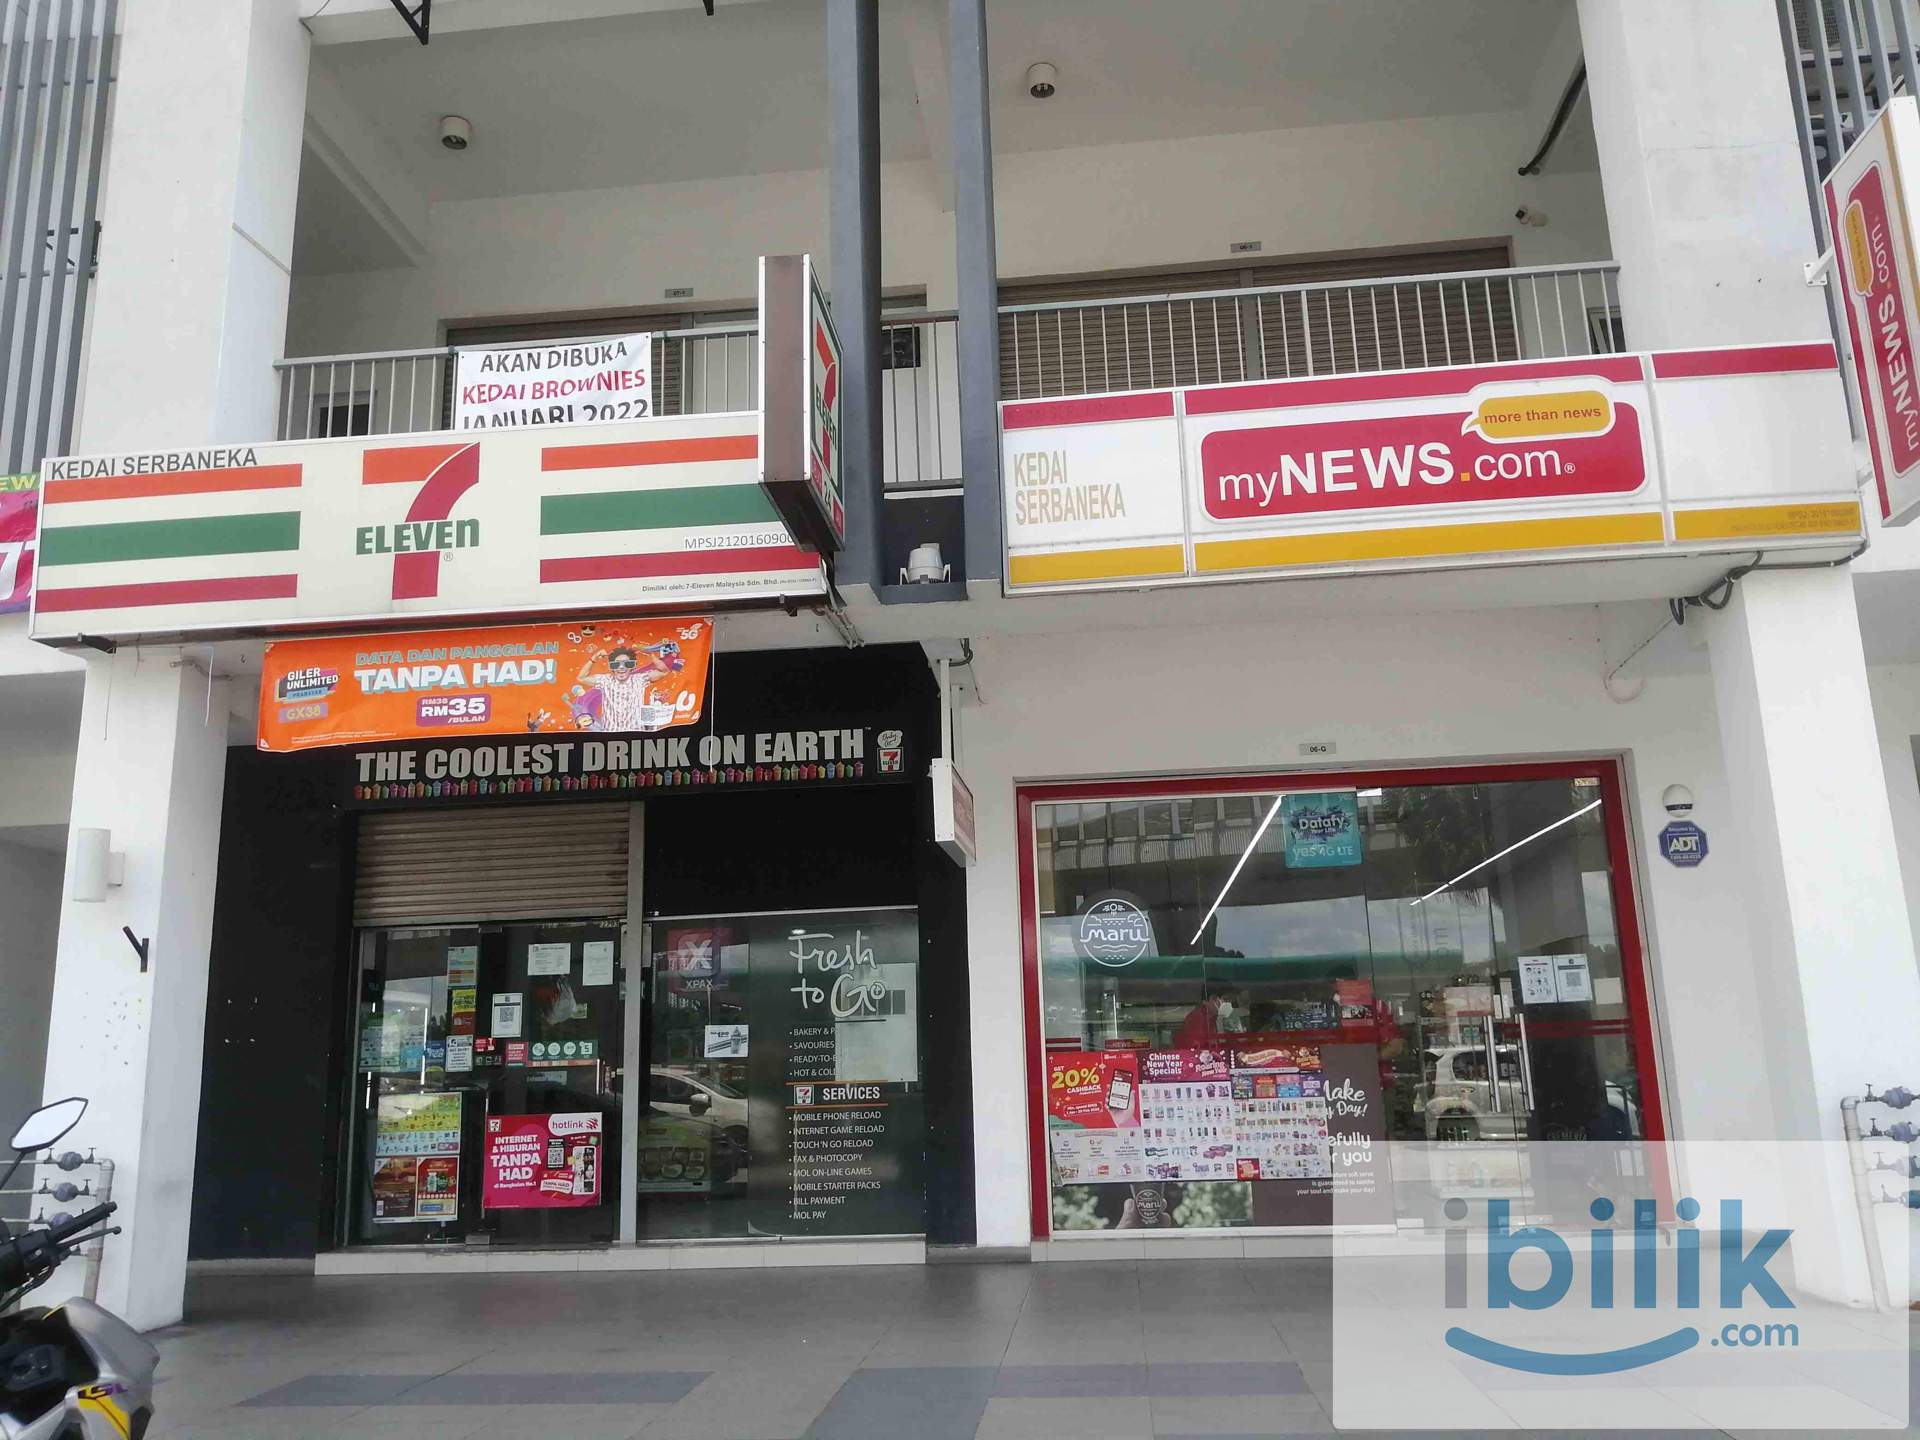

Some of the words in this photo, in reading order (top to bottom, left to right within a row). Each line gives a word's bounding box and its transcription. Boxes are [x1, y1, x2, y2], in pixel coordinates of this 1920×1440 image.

[481, 350, 541, 372] AKAN
[547, 341, 628, 369] DIBUKA
[463, 384, 526, 404] KEDAI
[532, 369, 645, 400] BROWNIES
[583, 398, 649, 422] 2022
[1484, 411, 1521, 425] more
[1525, 408, 1560, 422] than
[1563, 406, 1602, 420] news
[51, 458, 115, 480] KEDAI
[122, 448, 258, 475] SERBANEKA
[1014, 449, 1067, 487] KEDAI
[1219, 442, 1561, 508] myNEWS.com
[1015, 483, 1126, 525] SERBANEKA
[362, 442, 481, 600] 7
[686, 582, 715, 590] 7-Eleven
[716, 579, 746, 589] Malaysia
[679, 629, 698, 640] 5G
[355, 651, 404, 666] DATA
[407, 649, 447, 663] DAN
[451, 641, 559, 659] PANGGILAN
[287, 667, 321, 681] GILER
[354, 663, 468, 693] TANPA
[472, 657, 558, 687] HAD!
[287, 675, 338, 690] UNLIMITED
[286, 704, 321, 720] GX38
[421, 697, 486, 718] RM35
[448, 715, 486, 724] /BULAN
[355, 751, 416, 782] THE
[425, 743, 575, 779] COOLEST
[582, 737, 691, 773] DRINK
[699, 734, 745, 766] ON
[755, 729, 864, 763] EARTH
[1299, 814, 1345, 830] Datafy
[1670, 836, 1698, 852] ADT
[1319, 847, 1335, 857] 4G
[1337, 846, 1354, 856] LTE
[1080, 928, 1150, 942] maru
[788, 930, 876, 973] Fresh
[686, 979, 713, 990] XPAX
[791, 978, 824, 1008] to
[831, 974, 886, 1018] Go
[794, 1028, 821, 1036] BAKERY
[823, 1027, 829, 1035] &
[794, 1041, 835, 1050] SAVOURIES
[1149, 1053, 1180, 1061] Chinese
[1166, 1060, 1183, 1068] Year
[794, 1069, 809, 1077] HOT
[1051, 1067, 1100, 1089] 20%
[1150, 1067, 1182, 1075] Specials
[823, 1086, 880, 1100] SERVICES
[1067, 1085, 1102, 1094] CASHBACK
[793, 1113, 822, 1121] MOBILE
[823, 1112, 849, 1120] PHONE
[851, 1111, 881, 1119] RELOAD
[1336, 1101, 1368, 1117] Day!
[552, 1120, 584, 1129] hotlink
[793, 1126, 829, 1135] INTERNET
[830, 1126, 852, 1134] GAME
[854, 1125, 884, 1133] RELOAD
[495, 1135, 538, 1144] INTERNET
[793, 1140, 819, 1149] TOUCH
[829, 1140, 842, 1148] GO
[843, 1139, 873, 1147] RELOAD
[1328, 1132, 1371, 1149] efully
[500, 1143, 541, 1153] HIBURAN
[491, 1152, 542, 1167] TANPA
[793, 1155, 807, 1163] FAX
[809, 1155, 815, 1163] &
[816, 1153, 863, 1162] PHOTOCOPY
[1343, 1152, 1372, 1166] you
[499, 1167, 533, 1181] HAD
[793, 1169, 811, 1177] MOL
[812, 1168, 845, 1176] ON-LINE
[845, 1167, 872, 1175] GAMES
[793, 1183, 822, 1191] MOBILE
[824, 1182, 856, 1190] STARTER
[857, 1181, 881, 1189] PACKS
[793, 1197, 809, 1205] BILL
[810, 1196, 845, 1205] PAYMENT
[813, 1211, 826, 1219] PAY
